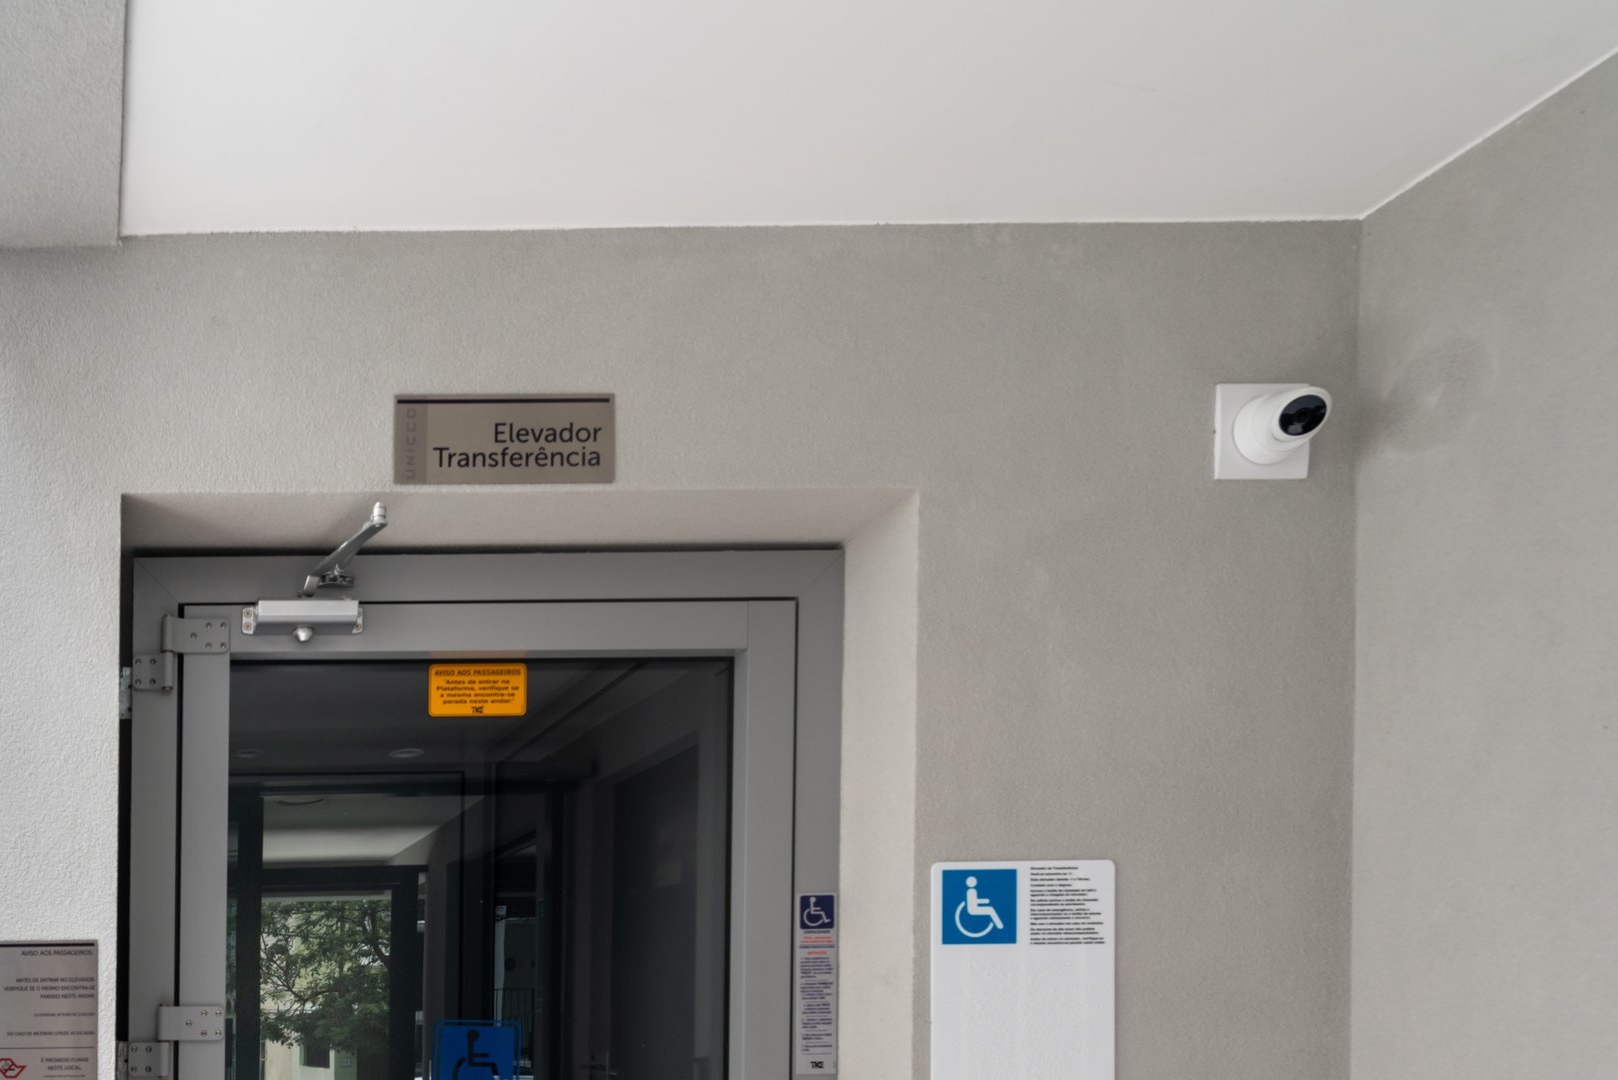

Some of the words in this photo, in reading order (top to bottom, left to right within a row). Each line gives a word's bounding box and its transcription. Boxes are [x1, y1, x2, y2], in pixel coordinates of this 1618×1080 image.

[494, 422, 602, 443] Elevador
[433, 446, 600, 467] Transferência
[473, 668, 521, 676] PASSAGEIROS
